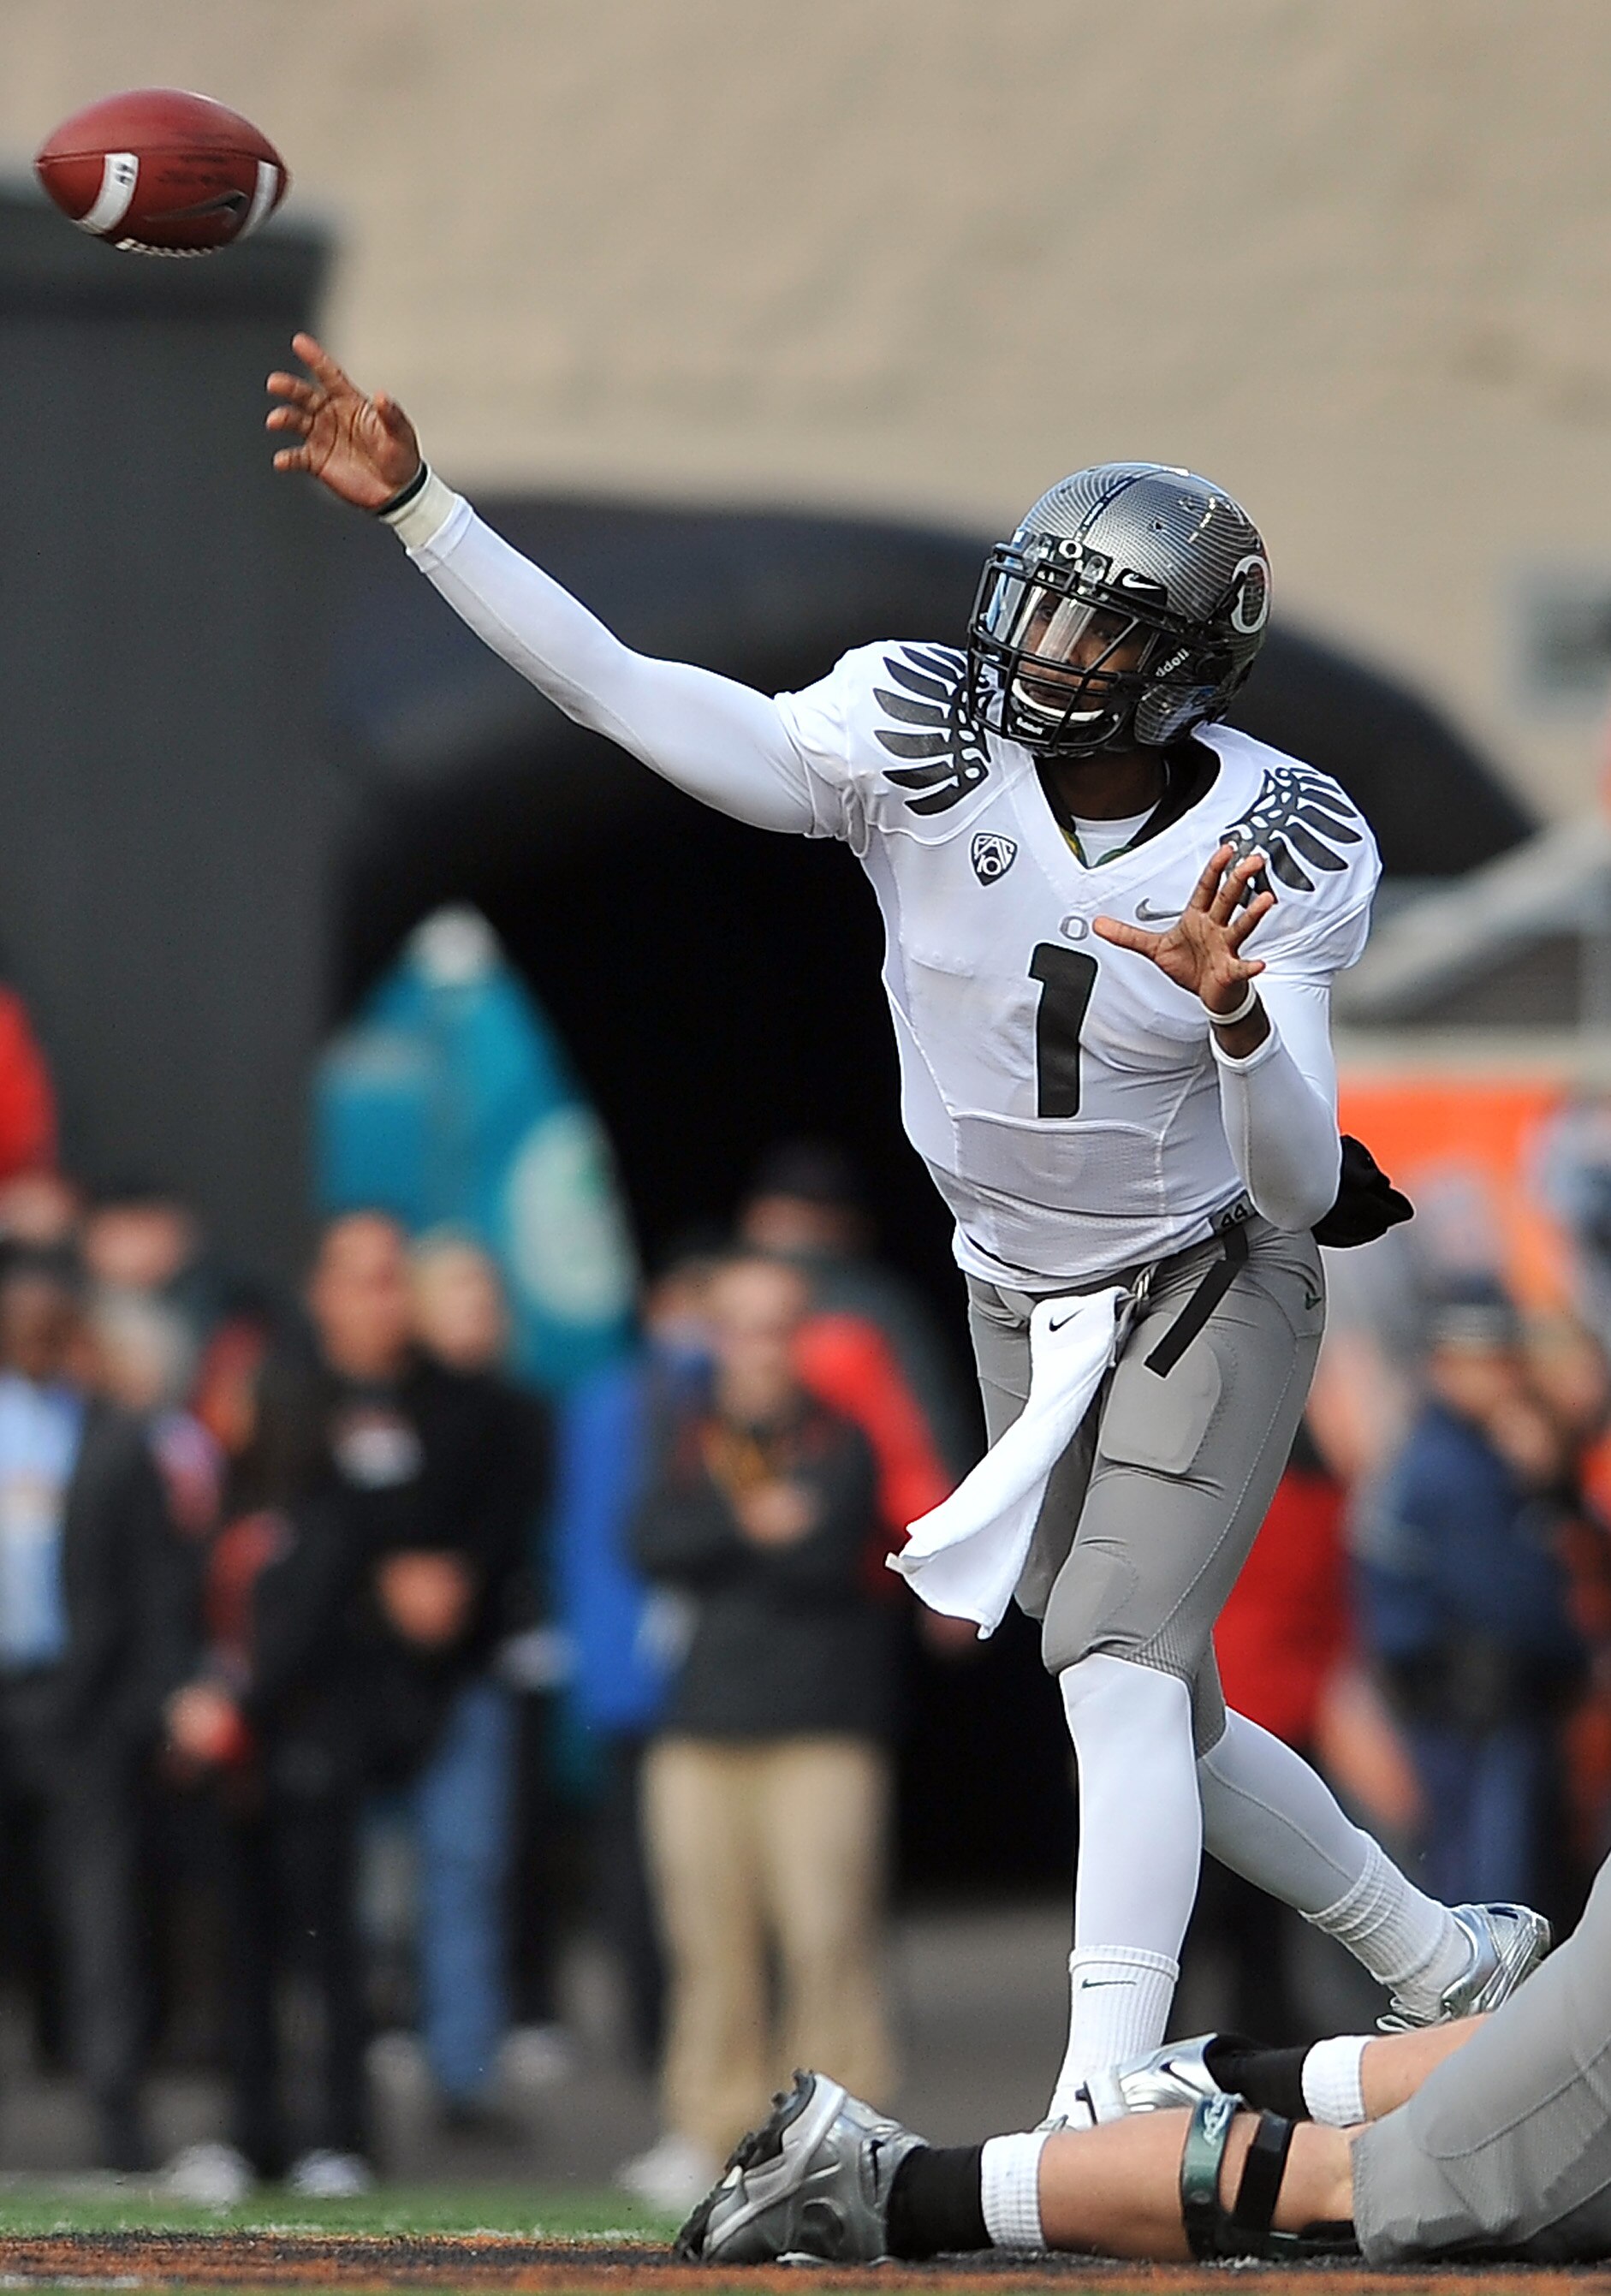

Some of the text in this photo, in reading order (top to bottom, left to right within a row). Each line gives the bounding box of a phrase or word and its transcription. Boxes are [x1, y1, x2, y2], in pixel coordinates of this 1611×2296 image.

[974, 835, 1014, 870] PAC
[977, 854, 1002, 876] 10
[1029, 943, 1098, 1118] 1
